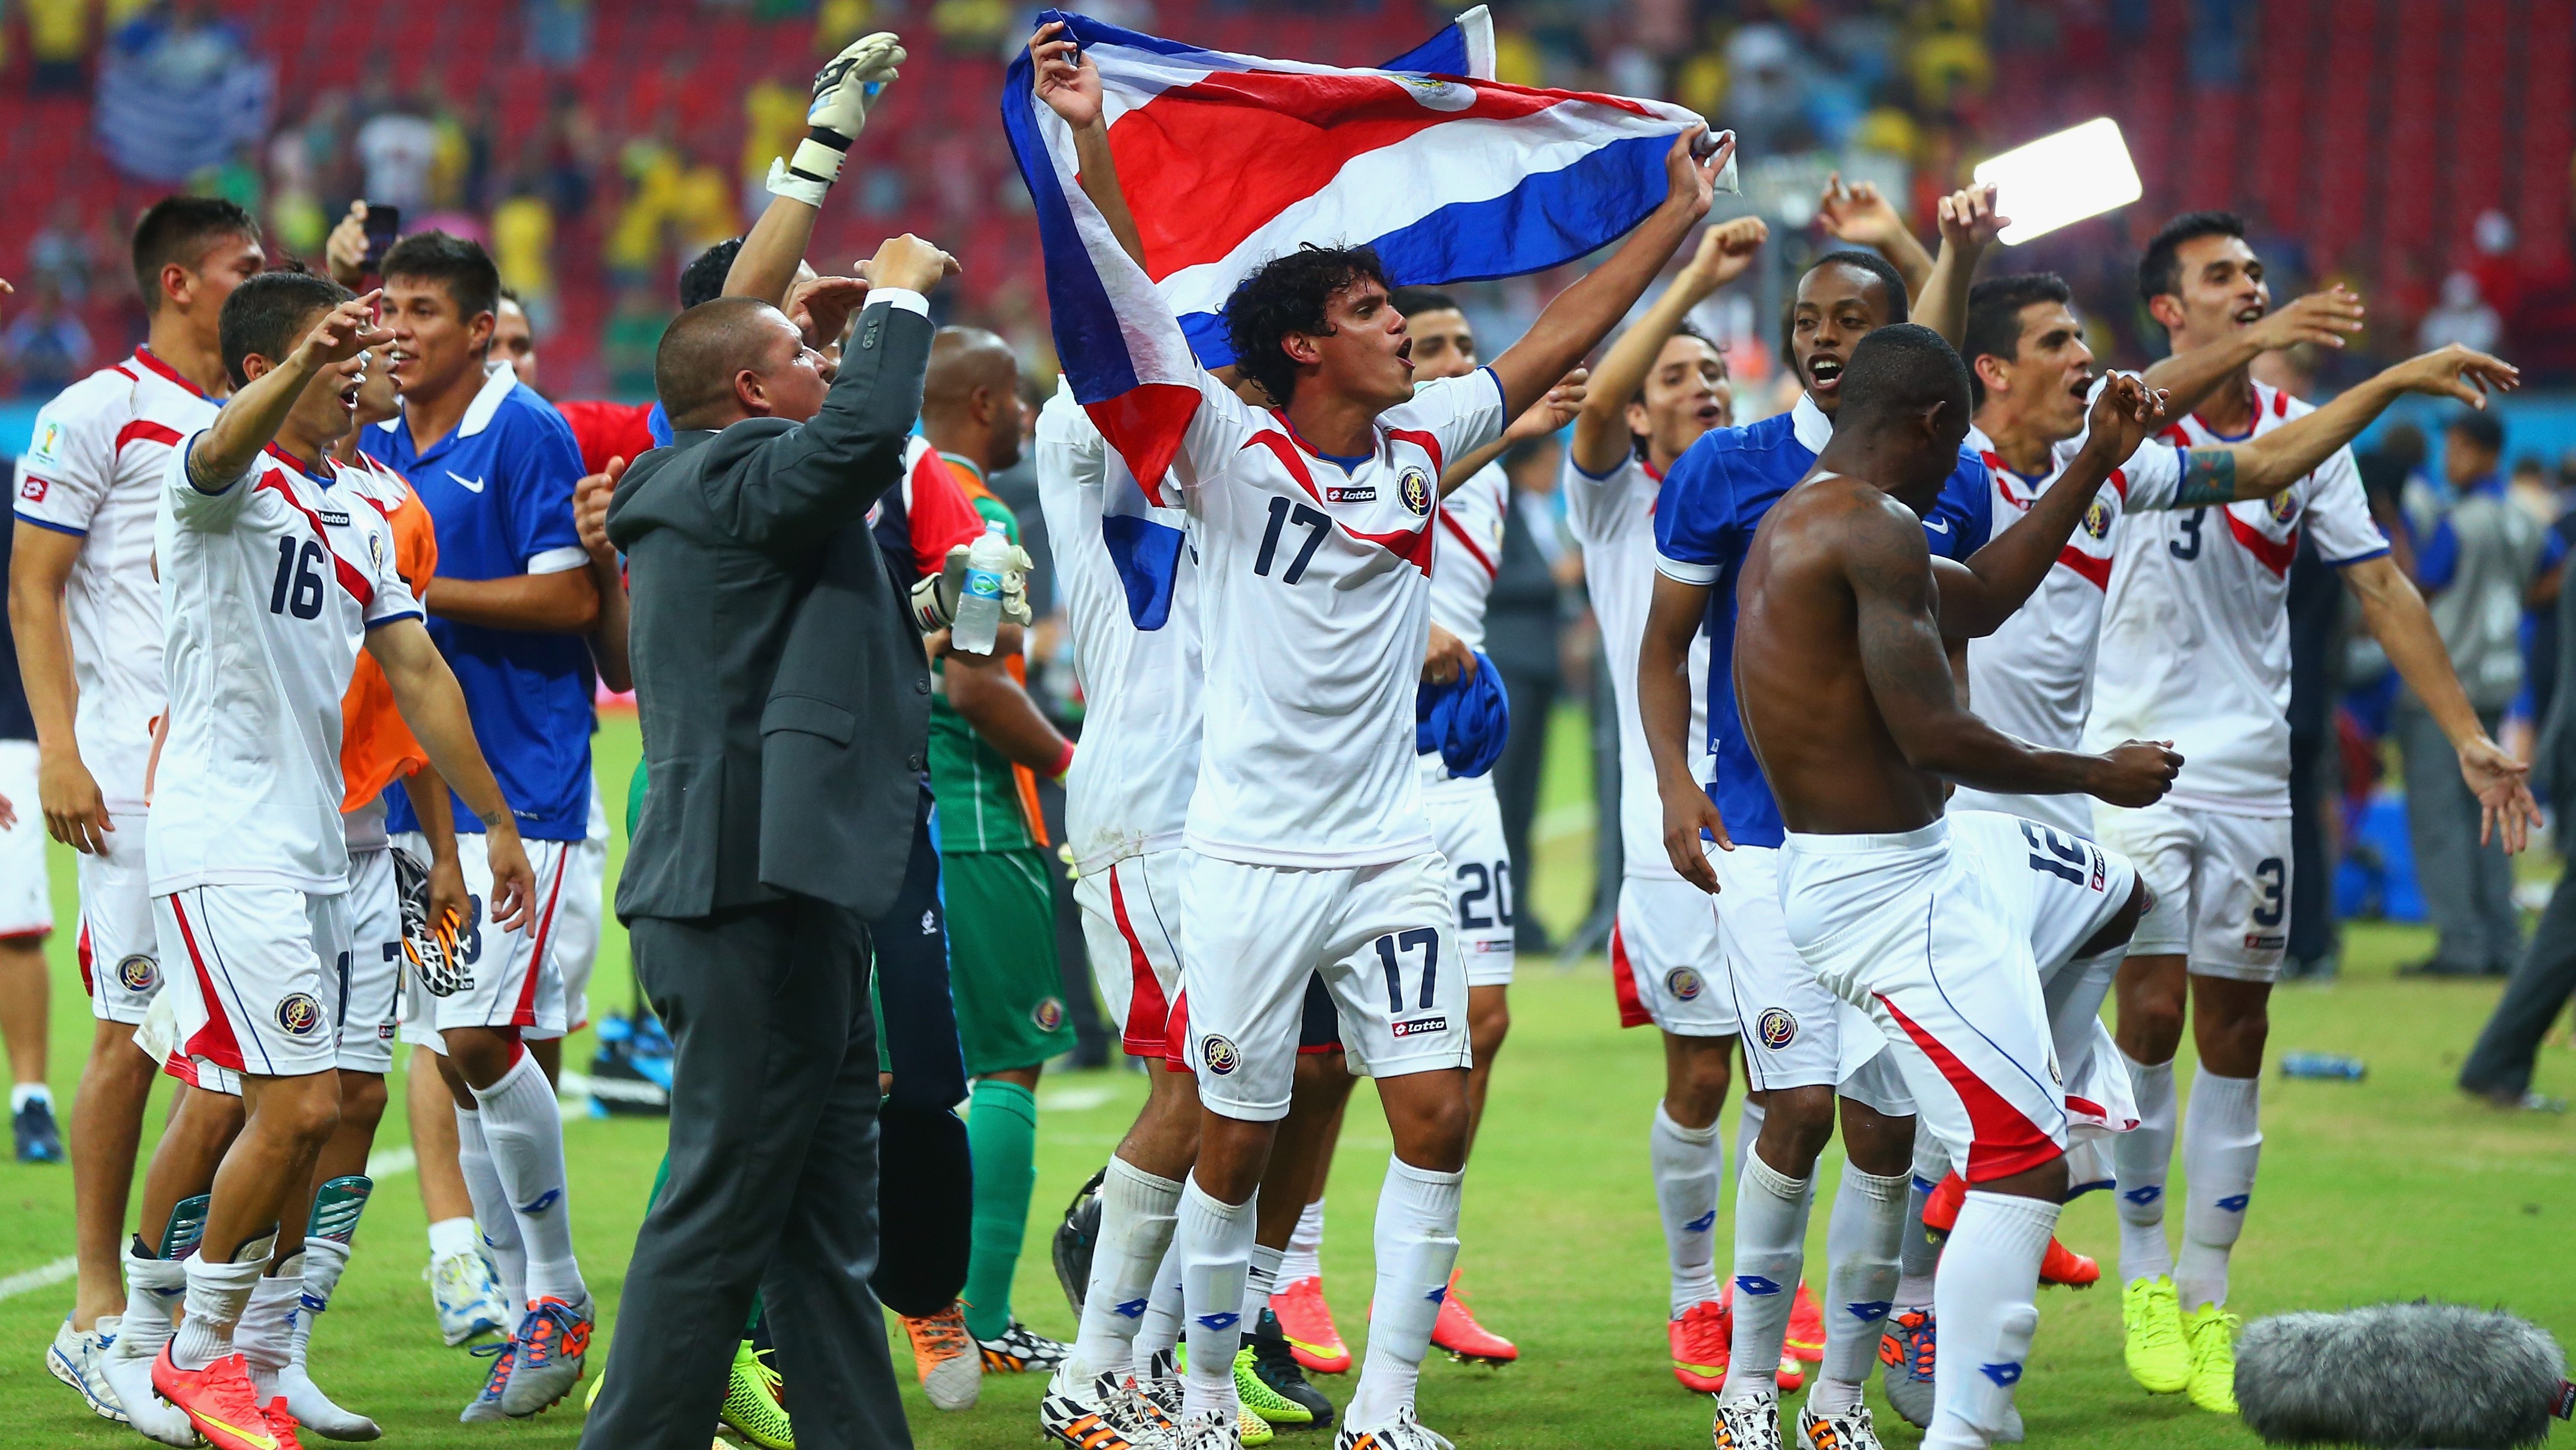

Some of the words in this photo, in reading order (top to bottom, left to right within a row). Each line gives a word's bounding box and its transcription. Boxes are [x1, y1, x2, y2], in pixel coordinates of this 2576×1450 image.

[320, 512, 348, 524] lotto
[1342, 490, 1375, 500] lotto
[1254, 496, 1332, 585] 17
[2170, 506, 2206, 560] 3
[271, 536, 324, 620] 16
[2018, 818, 2086, 885] 12
[2253, 857, 2285, 926] 3
[1375, 927, 1439, 1014] 17
[1408, 1020, 1445, 1033] lotto
